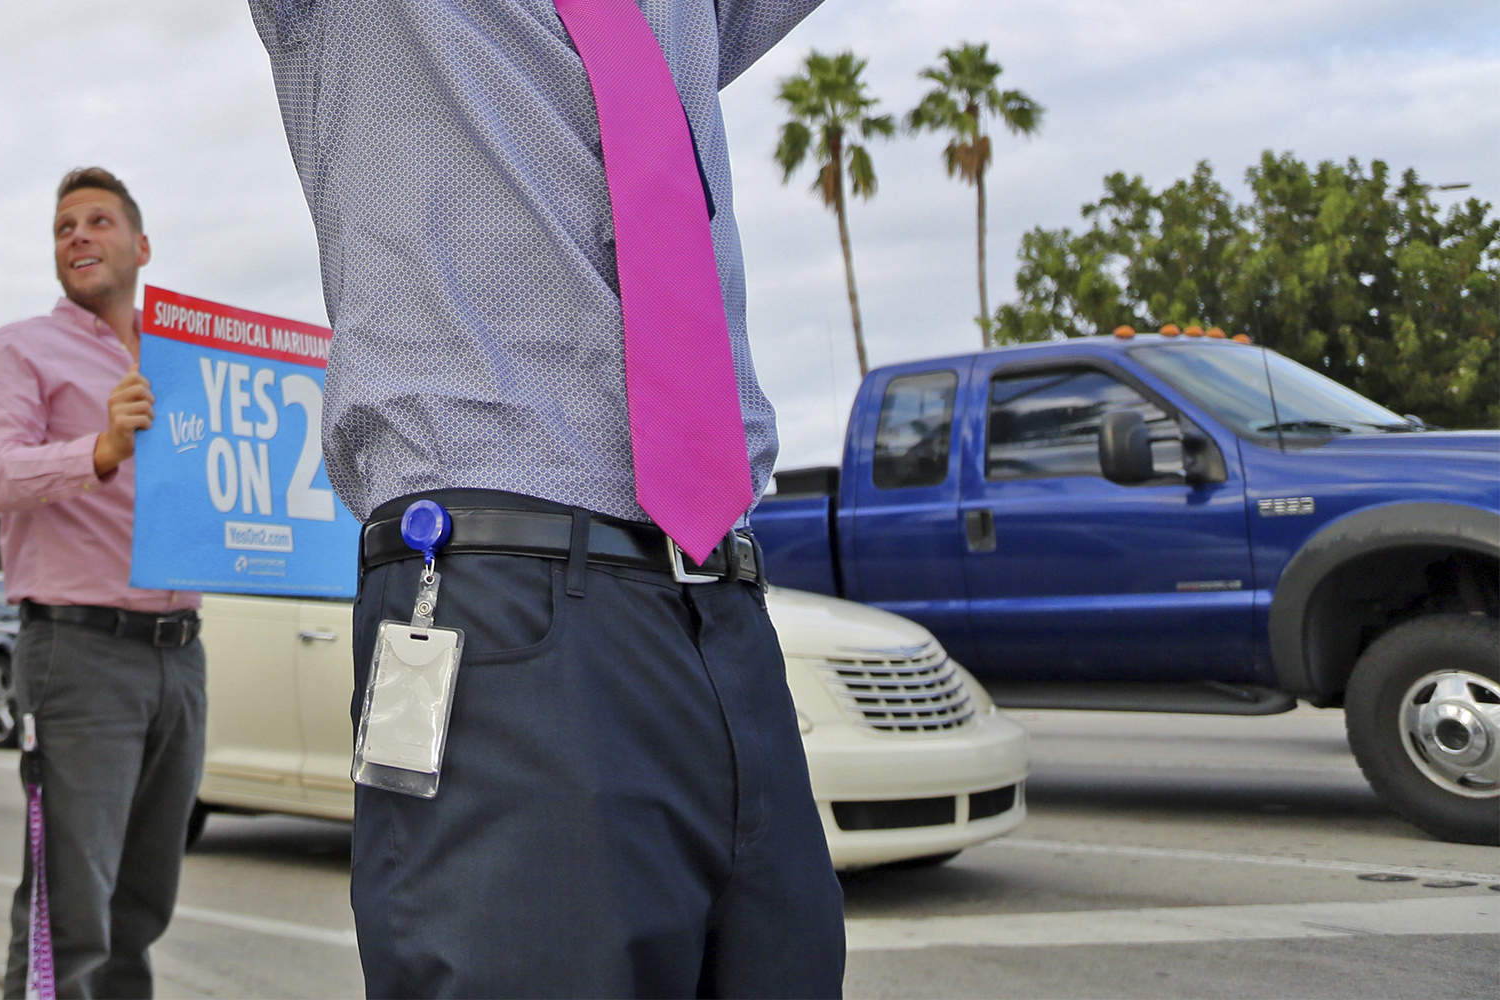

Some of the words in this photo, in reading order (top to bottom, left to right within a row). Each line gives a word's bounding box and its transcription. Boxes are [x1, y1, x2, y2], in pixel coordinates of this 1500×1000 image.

[153, 301, 213, 337] SUPPORT
[213, 315, 270, 350] MEDICAL
[168, 411, 206, 446] Vote
[199, 356, 280, 441] YES
[205, 436, 273, 516] ON
[280, 373, 336, 522] 2
